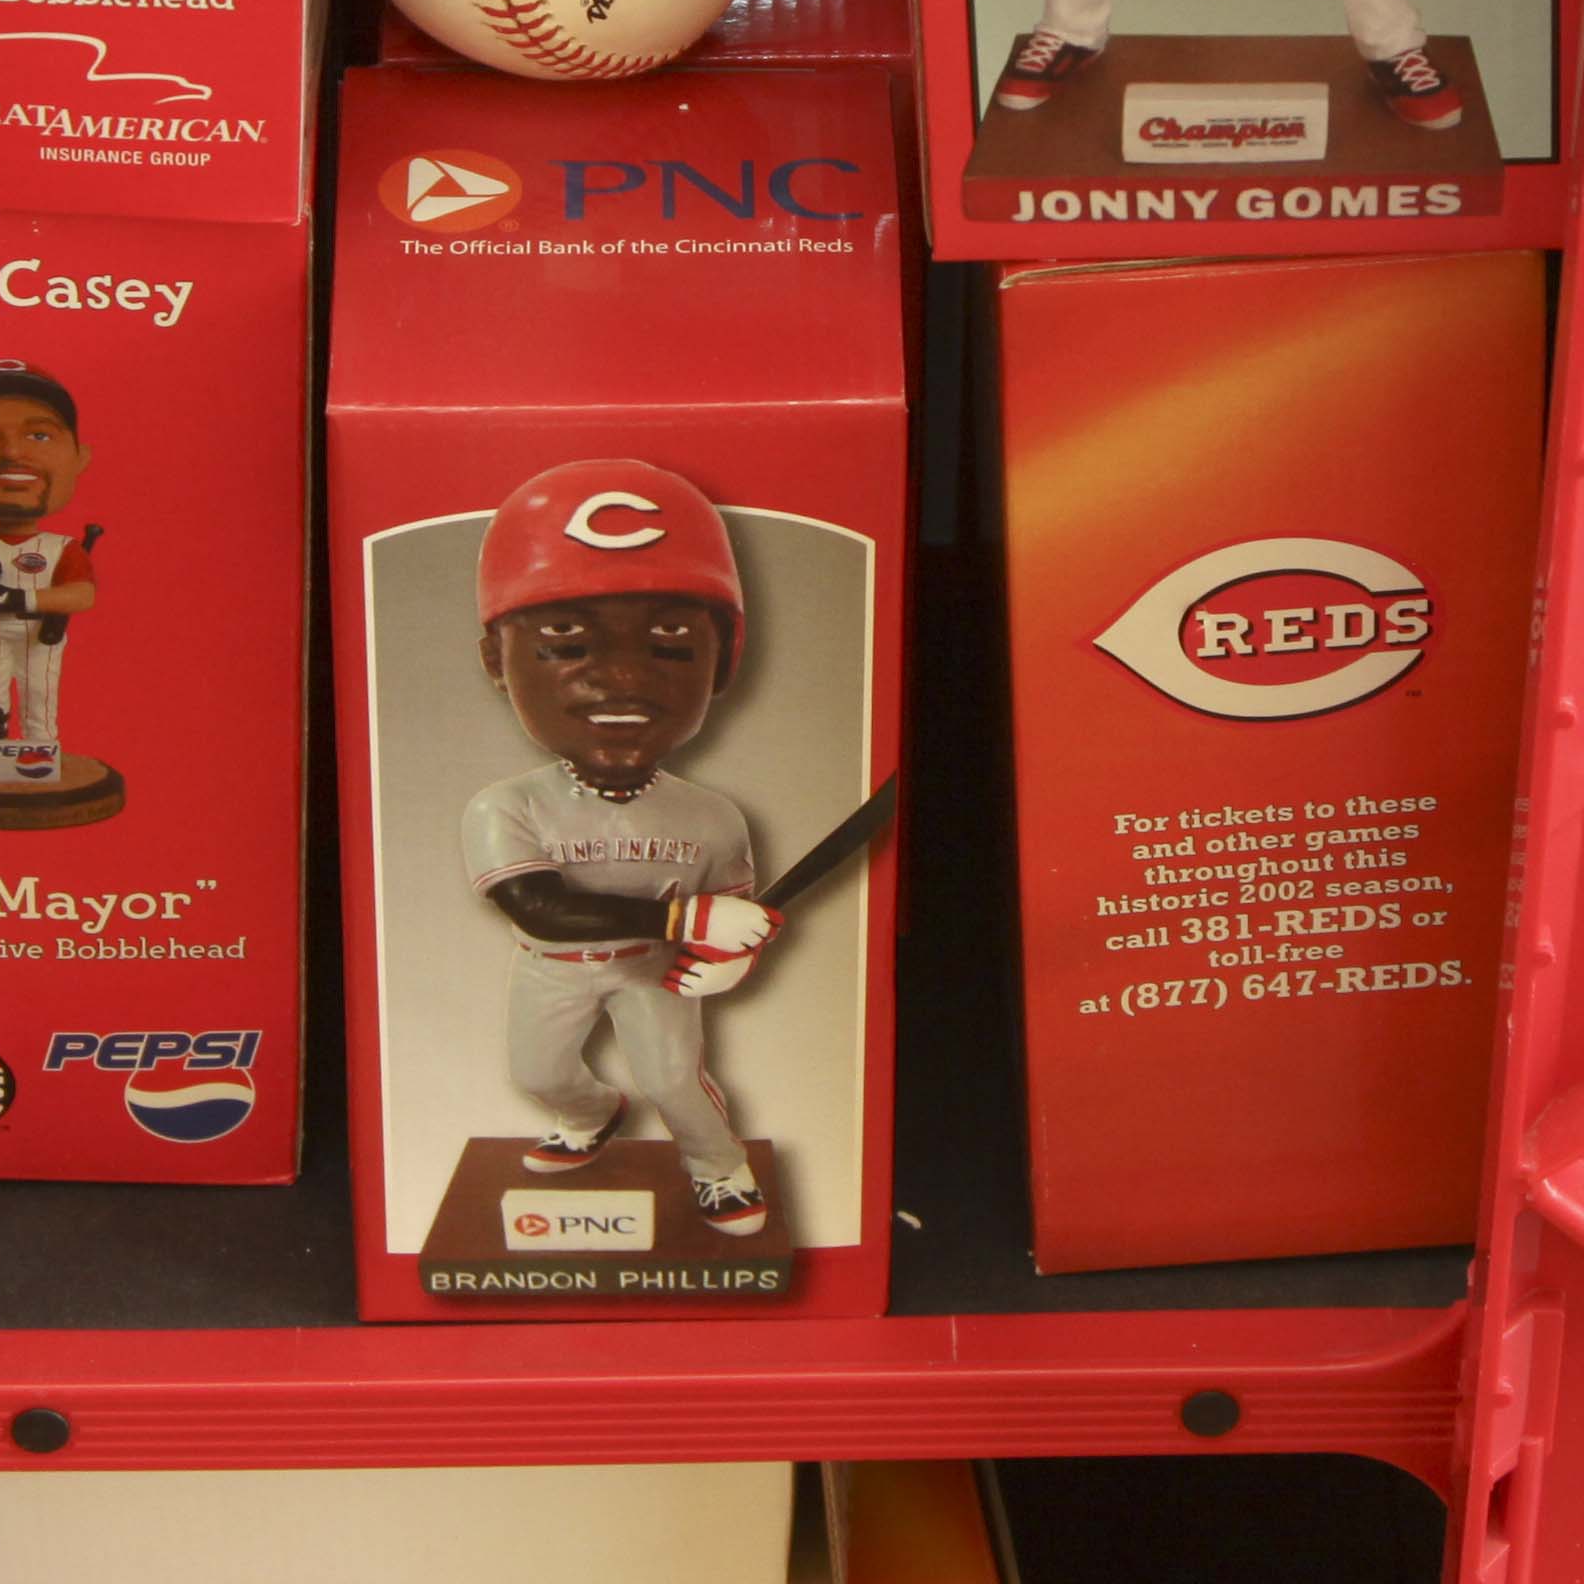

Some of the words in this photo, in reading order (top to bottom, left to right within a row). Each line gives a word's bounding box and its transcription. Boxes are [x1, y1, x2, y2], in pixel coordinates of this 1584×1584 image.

[1139, 116, 1307, 149] Champion
[40, 146, 144, 166] INSURANCE
[149, 150, 212, 168] GROUP
[548, 157, 865, 222] PNC
[1011, 187, 1220, 224] JONNY
[1235, 184, 1462, 219] GOMES
[399, 239, 444, 256] The
[450, 238, 532, 256] Official
[538, 238, 596, 256] Bank
[602, 238, 627, 255] of
[631, 238, 669, 255] the
[675, 237, 792, 255] Cincinnati
[799, 237, 854, 254] Reds
[1195, 598, 1430, 658] REDS
[1114, 813, 1169, 835] For
[1178, 805, 1294, 830] tickets
[1303, 801, 1336, 820] to
[1345, 795, 1438, 817] these
[1132, 835, 1196, 861] and
[1205, 831, 1296, 855] other
[1304, 823, 1420, 852] games
[1143, 852, 1335, 886] throughout
[1343, 847, 1408, 870] this
[1096, 887, 1230, 917] historic
[1239, 879, 1315, 905] 2002
[1325, 874, 1454, 898] season,
[1105, 926, 1170, 951] call
[1180, 902, 1402, 945] 381-REDS
[1411, 910, 1448, 927] or
[55, 935, 247, 962] Bobblehead
[1207, 942, 1344, 968] toll-free
[1079, 994, 1111, 1015] at
[1119, 978, 1229, 1017] (877)
[1241, 959, 1474, 1001] 647-REDS.
[43, 1030, 263, 1072] PEPSI
[557, 1215, 638, 1235] PNC
[429, 1271, 598, 1291] BRANDON
[618, 1269, 780, 1291] PHILLIPS
